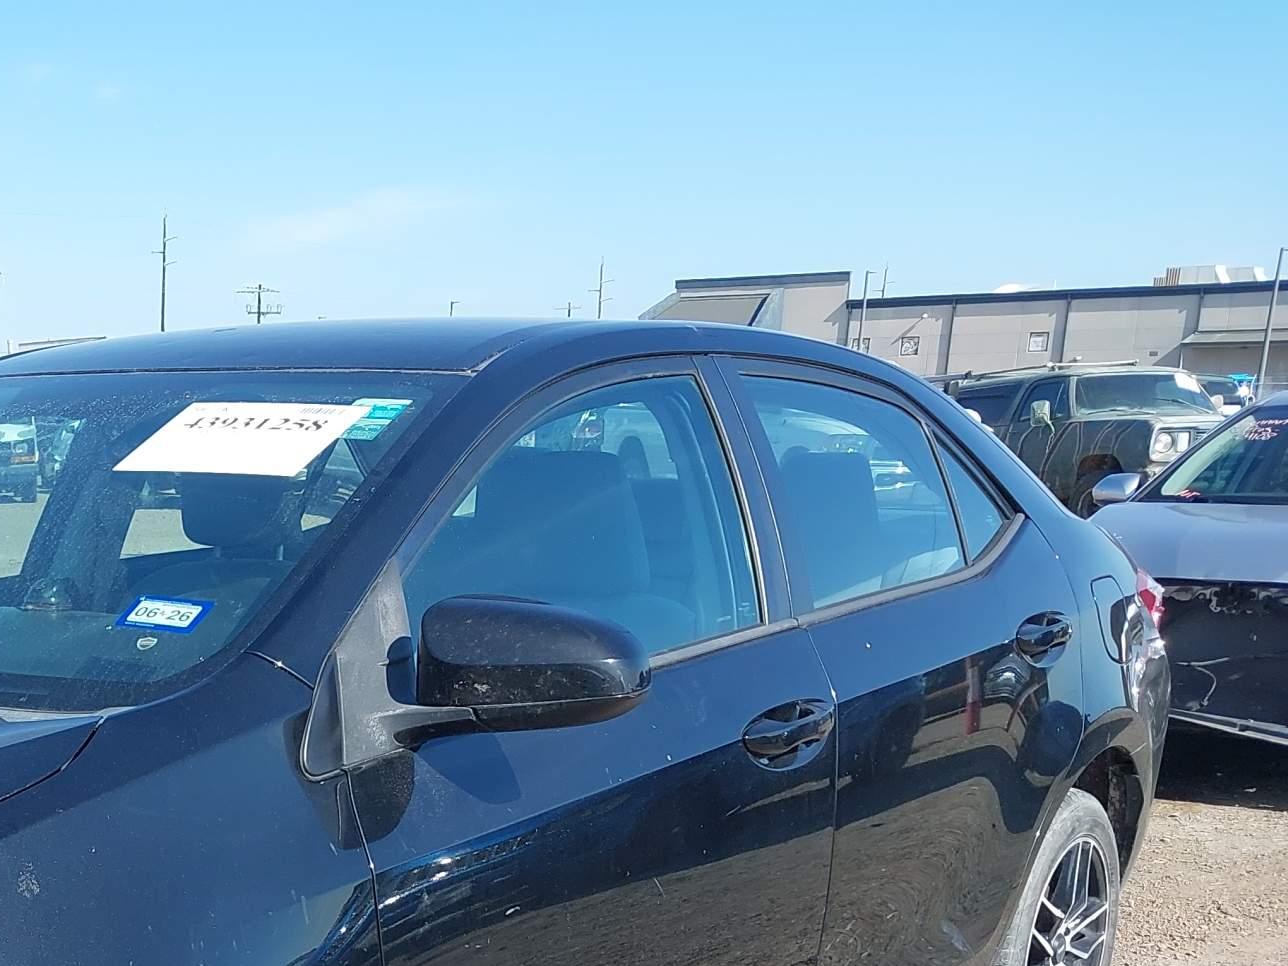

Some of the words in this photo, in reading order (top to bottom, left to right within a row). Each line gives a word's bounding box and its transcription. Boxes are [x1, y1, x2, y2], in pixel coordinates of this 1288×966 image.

[183, 416, 329, 431] 43931258
[134, 606, 160, 618] 06
[166, 609, 193, 622] 26
